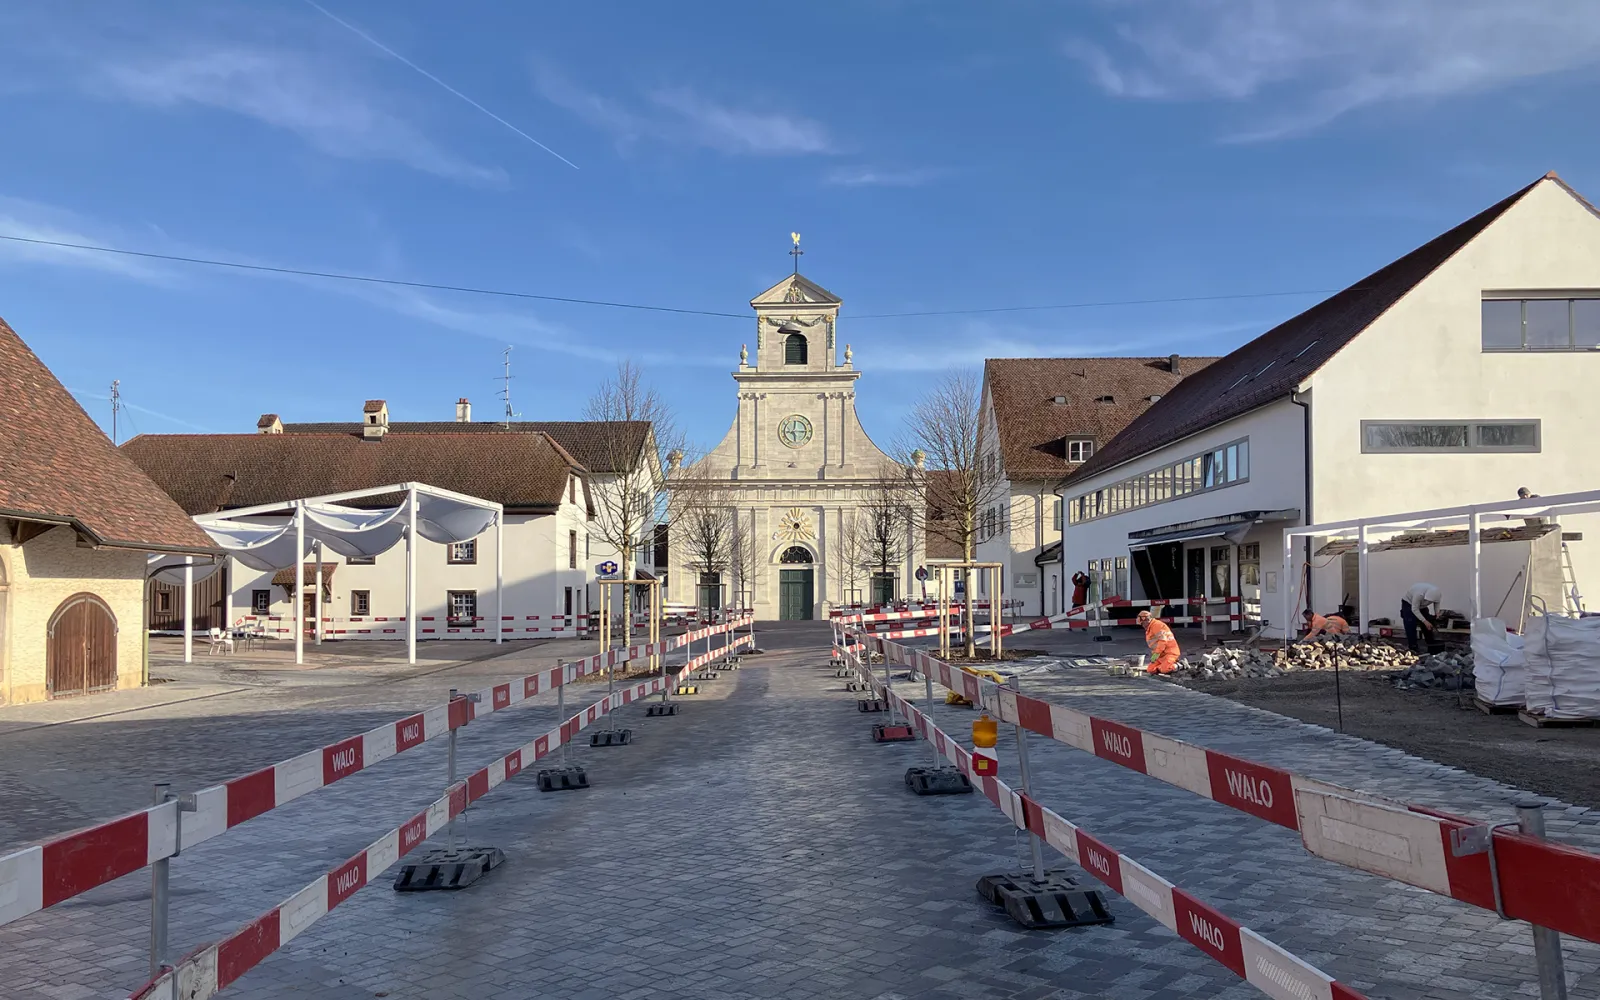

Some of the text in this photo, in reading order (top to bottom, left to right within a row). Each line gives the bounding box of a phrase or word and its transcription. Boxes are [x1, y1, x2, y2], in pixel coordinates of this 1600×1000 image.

[402, 723, 419, 743] WALO
[1101, 729, 1132, 759] WALO
[332, 748, 355, 772] WALO
[1224, 768, 1273, 809] WALO
[405, 823, 421, 846] WALO
[1087, 846, 1110, 877] WALO
[337, 866, 359, 895] WALO
[1188, 910, 1225, 952] WALO
